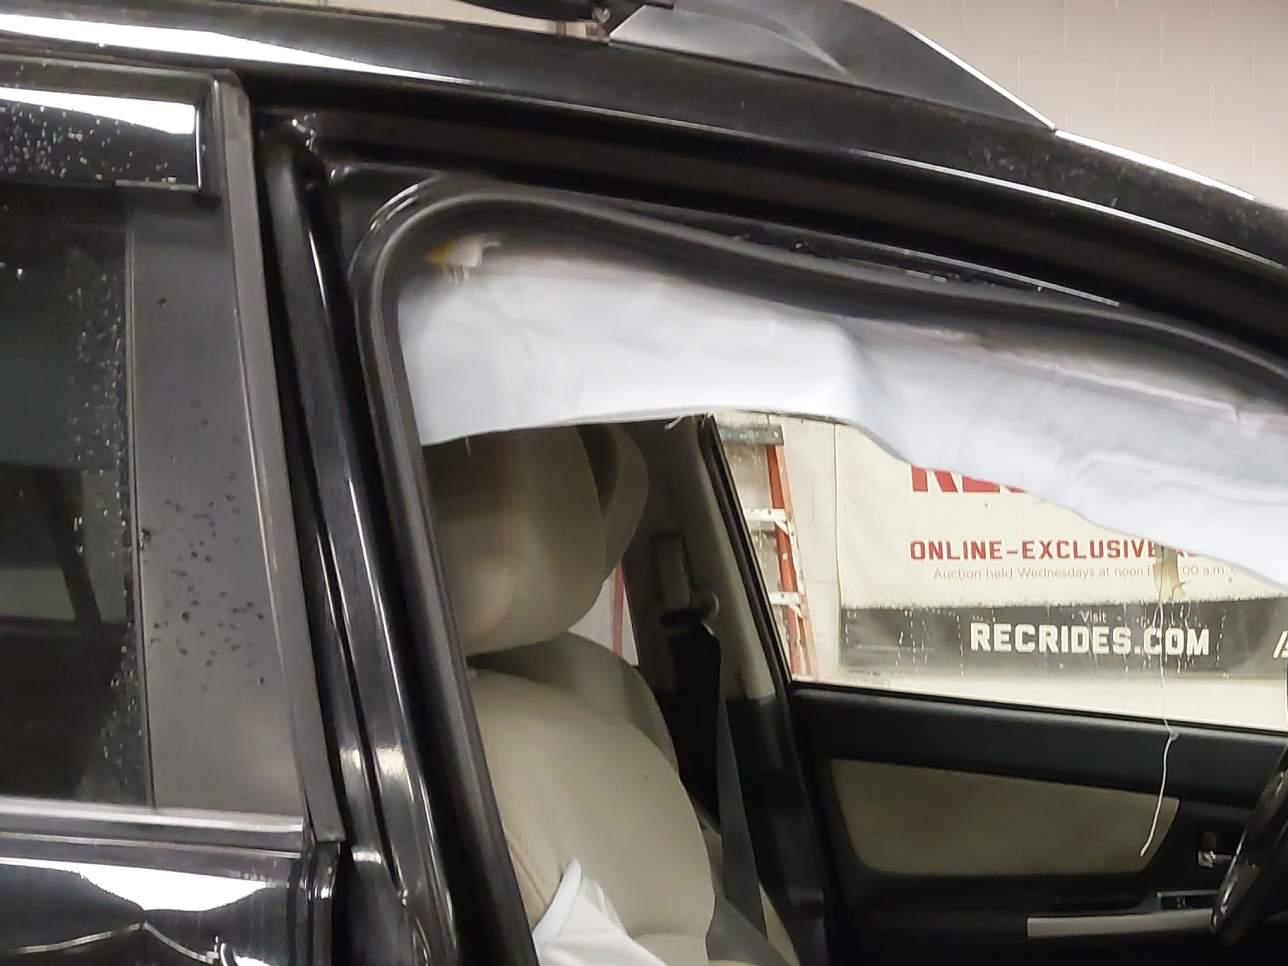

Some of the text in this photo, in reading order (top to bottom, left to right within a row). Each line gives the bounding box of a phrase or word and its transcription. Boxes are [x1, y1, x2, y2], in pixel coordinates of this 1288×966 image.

[933, 568, 981, 580] Auction
[986, 567, 1013, 579] held
[1018, 567, 1094, 580] Wednesdays
[1099, 567, 1111, 578] at
[1114, 567, 1144, 578] noon
[1079, 610, 1107, 623] Visit
[970, 623, 1209, 655] RECRIDES.COM
